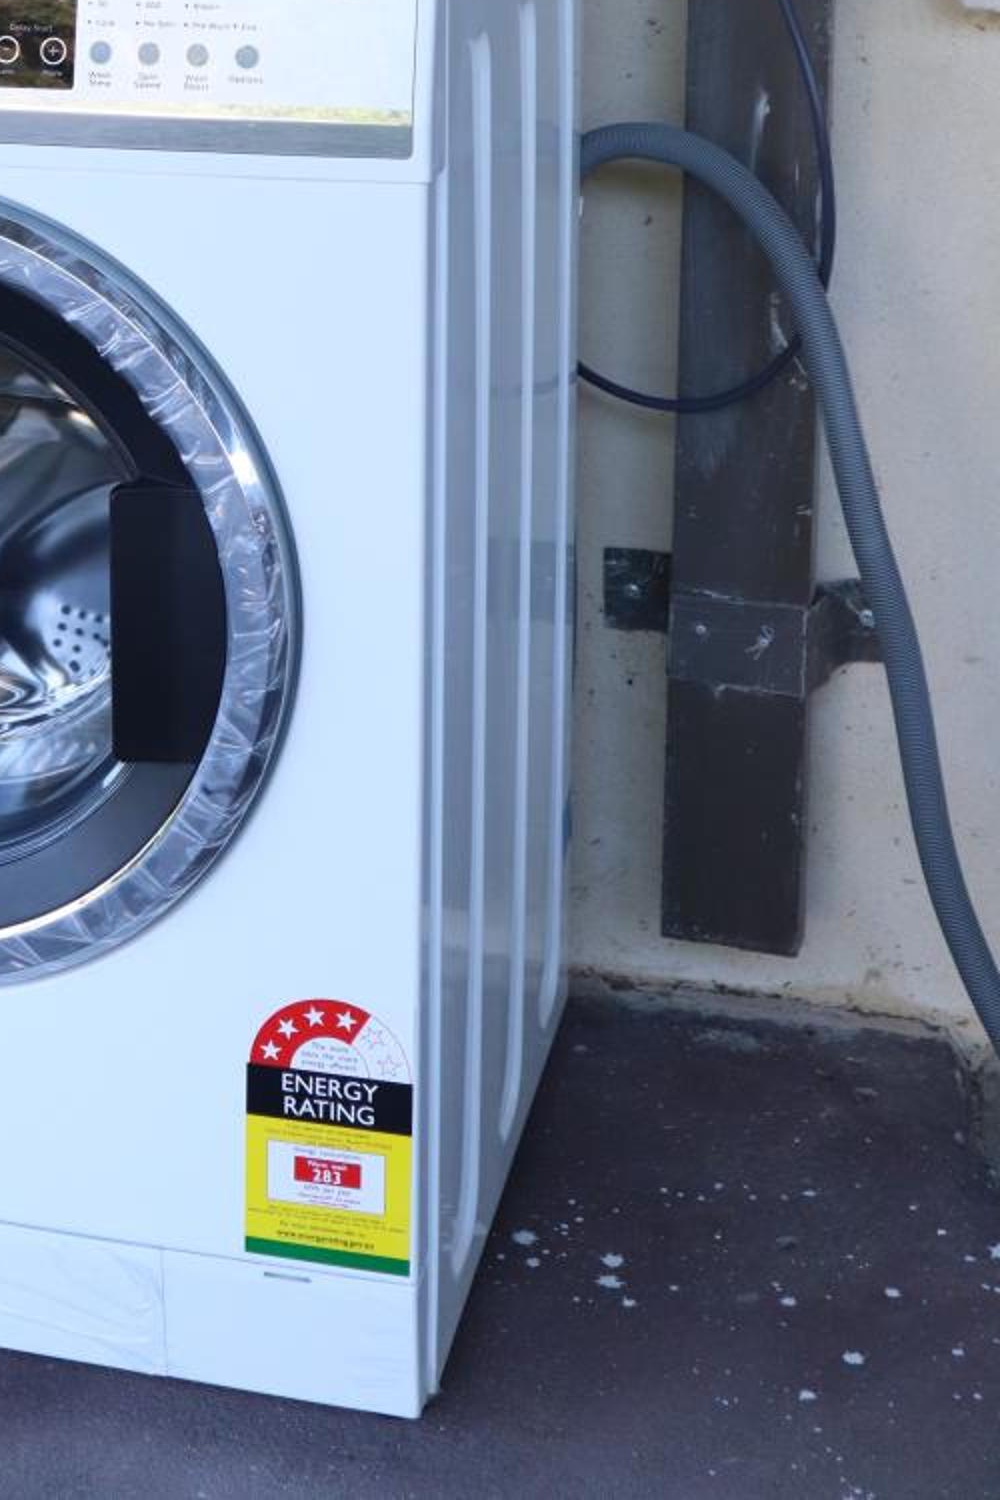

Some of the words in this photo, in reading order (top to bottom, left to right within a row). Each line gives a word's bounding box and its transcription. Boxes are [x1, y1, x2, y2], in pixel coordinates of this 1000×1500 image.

[281, 1072, 378, 1104] ENERGY
[283, 1095, 376, 1126] RATING
[312, 1168, 342, 1186] 283
